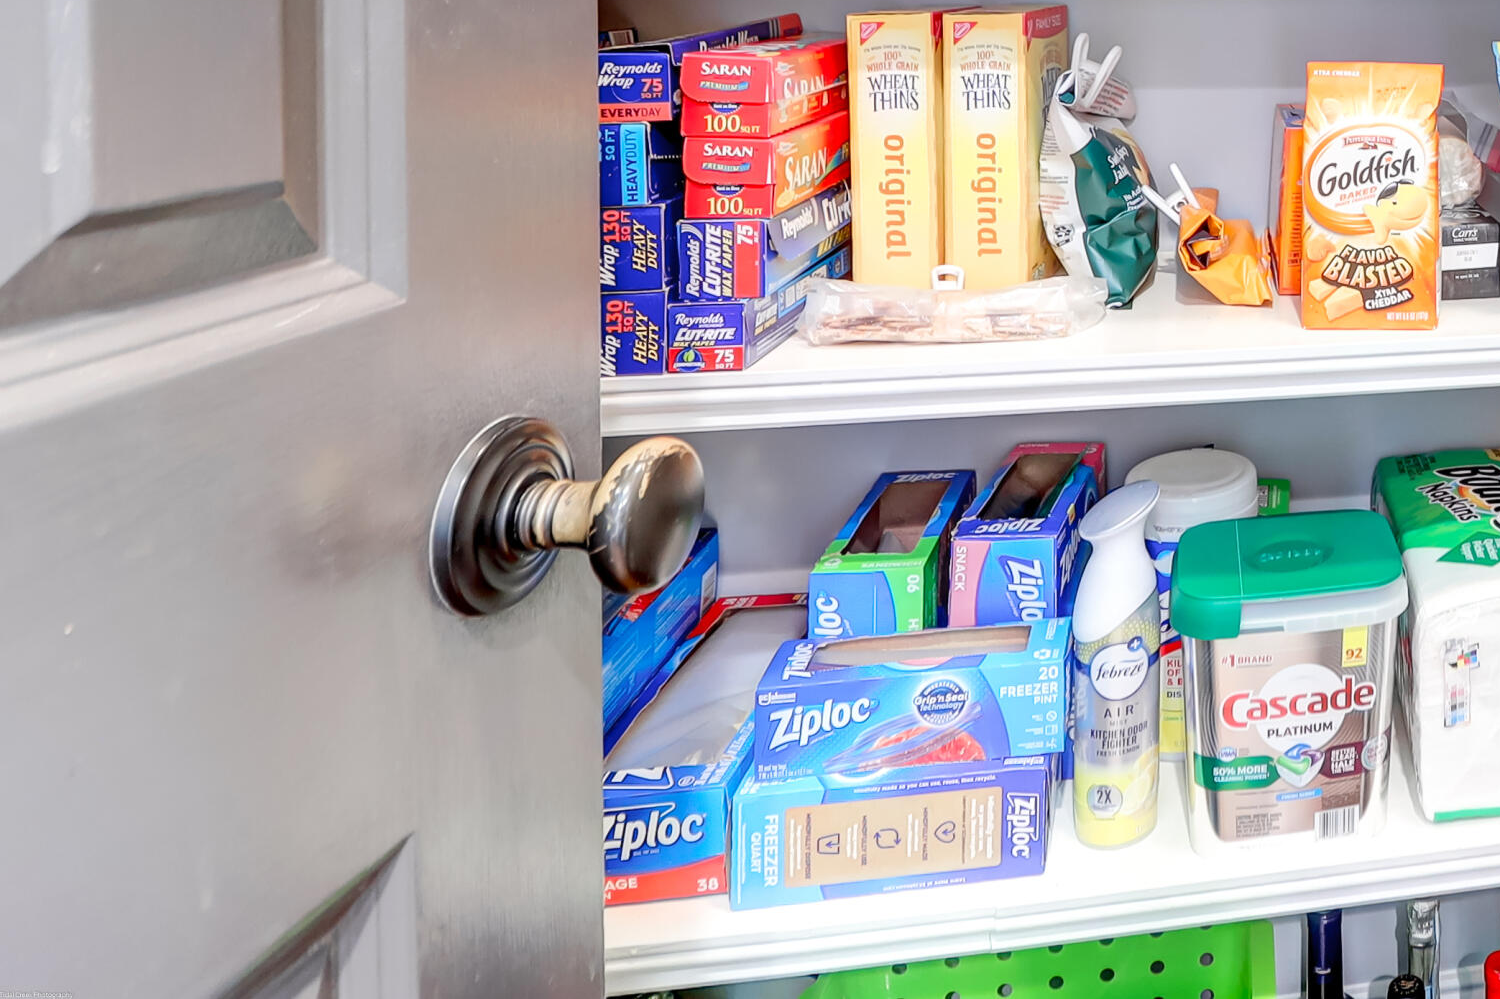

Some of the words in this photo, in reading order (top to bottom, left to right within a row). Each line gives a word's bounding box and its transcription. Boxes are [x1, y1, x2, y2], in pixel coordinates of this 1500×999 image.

[600, 62, 662, 75] Reynolds
[701, 62, 751, 76] SARAN
[867, 62, 892, 73] WHOLE
[896, 62, 919, 72] GRAIN
[960, 62, 984, 72] WHOLE
[989, 62, 1011, 71] GRAIN
[597, 75, 634, 89] Wrap
[641, 79, 663, 93] 75
[867, 74, 919, 91] WHEAT
[960, 73, 1012, 90] WHEAT
[868, 89, 920, 112] THINS
[961, 89, 1011, 111] THINS
[600, 108, 662, 118] EVERYDAY
[704, 115, 741, 133] 100
[752, 125, 760, 133] FT
[605, 129, 615, 143] FT
[605, 145, 615, 161] SQ
[703, 143, 753, 157] SARAN
[624, 130, 638, 202] HEAVYDUTY
[785, 147, 827, 191] SARAN
[1318, 148, 1416, 197] Goldfish
[879, 135, 912, 260] original
[971, 133, 1003, 257] original
[707, 197, 744, 215] 100
[744, 207, 754, 215] SQ
[754, 207, 763, 215] FT
[632, 220, 646, 273] HEAVY
[647, 231, 658, 269] DUTY
[1340, 245, 1397, 265] FLAVOR
[686, 235, 700, 297] Reynolds
[1323, 256, 1413, 288] BLASTED
[1365, 292, 1412, 310] CHEDDAR
[1375, 287, 1397, 298] XTRA
[675, 313, 724, 327] Reynolds
[633, 311, 648, 364] HEAVY
[648, 321, 659, 361] DUTY
[715, 350, 735, 363] 75
[896, 472, 956, 483] Ziploc
[1416, 482, 1480, 522] Napkins
[956, 546, 966, 590] SNACK
[1346, 648, 1363, 659] 92
[1039, 667, 1058, 679] 20
[1167, 669, 1180, 678] OF
[1000, 683, 1058, 698] FREEZER
[1034, 693, 1058, 705] PINT
[1222, 677, 1374, 728] Cascade
[1103, 704, 1134, 719] AIR
[768, 698, 871, 750] Ziploc
[1267, 721, 1333, 738] PLATINUM
[1213, 767, 1236, 776] 50%
[1237, 764, 1267, 775] MORE
[764, 814, 779, 887] FREEZER
[697, 878, 719, 892] 38
